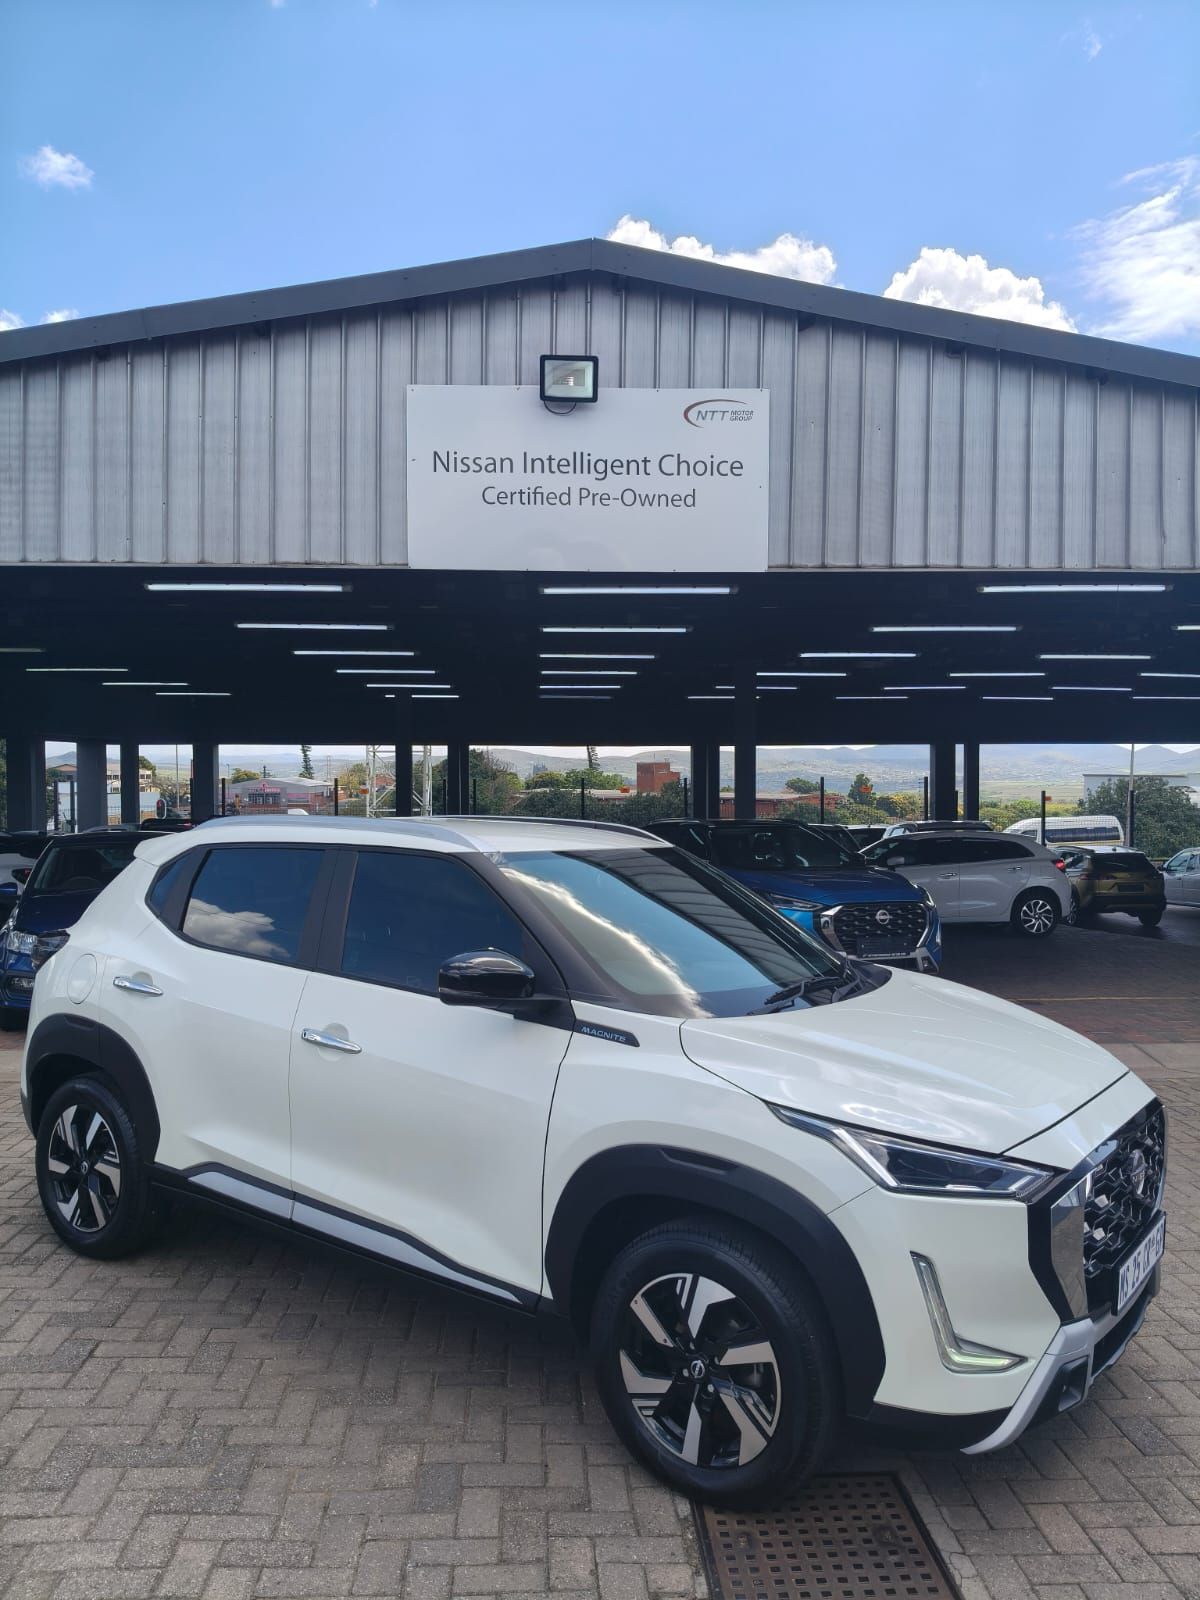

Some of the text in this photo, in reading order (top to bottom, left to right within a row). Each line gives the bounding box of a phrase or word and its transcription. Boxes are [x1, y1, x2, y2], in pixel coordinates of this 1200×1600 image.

[695, 410, 730, 421] NTT
[432, 450, 744, 481] Nissan Intelligent Choice
[481, 485, 697, 508] Certified Pre-Owned
[581, 1026, 626, 1041] MAGNITE
